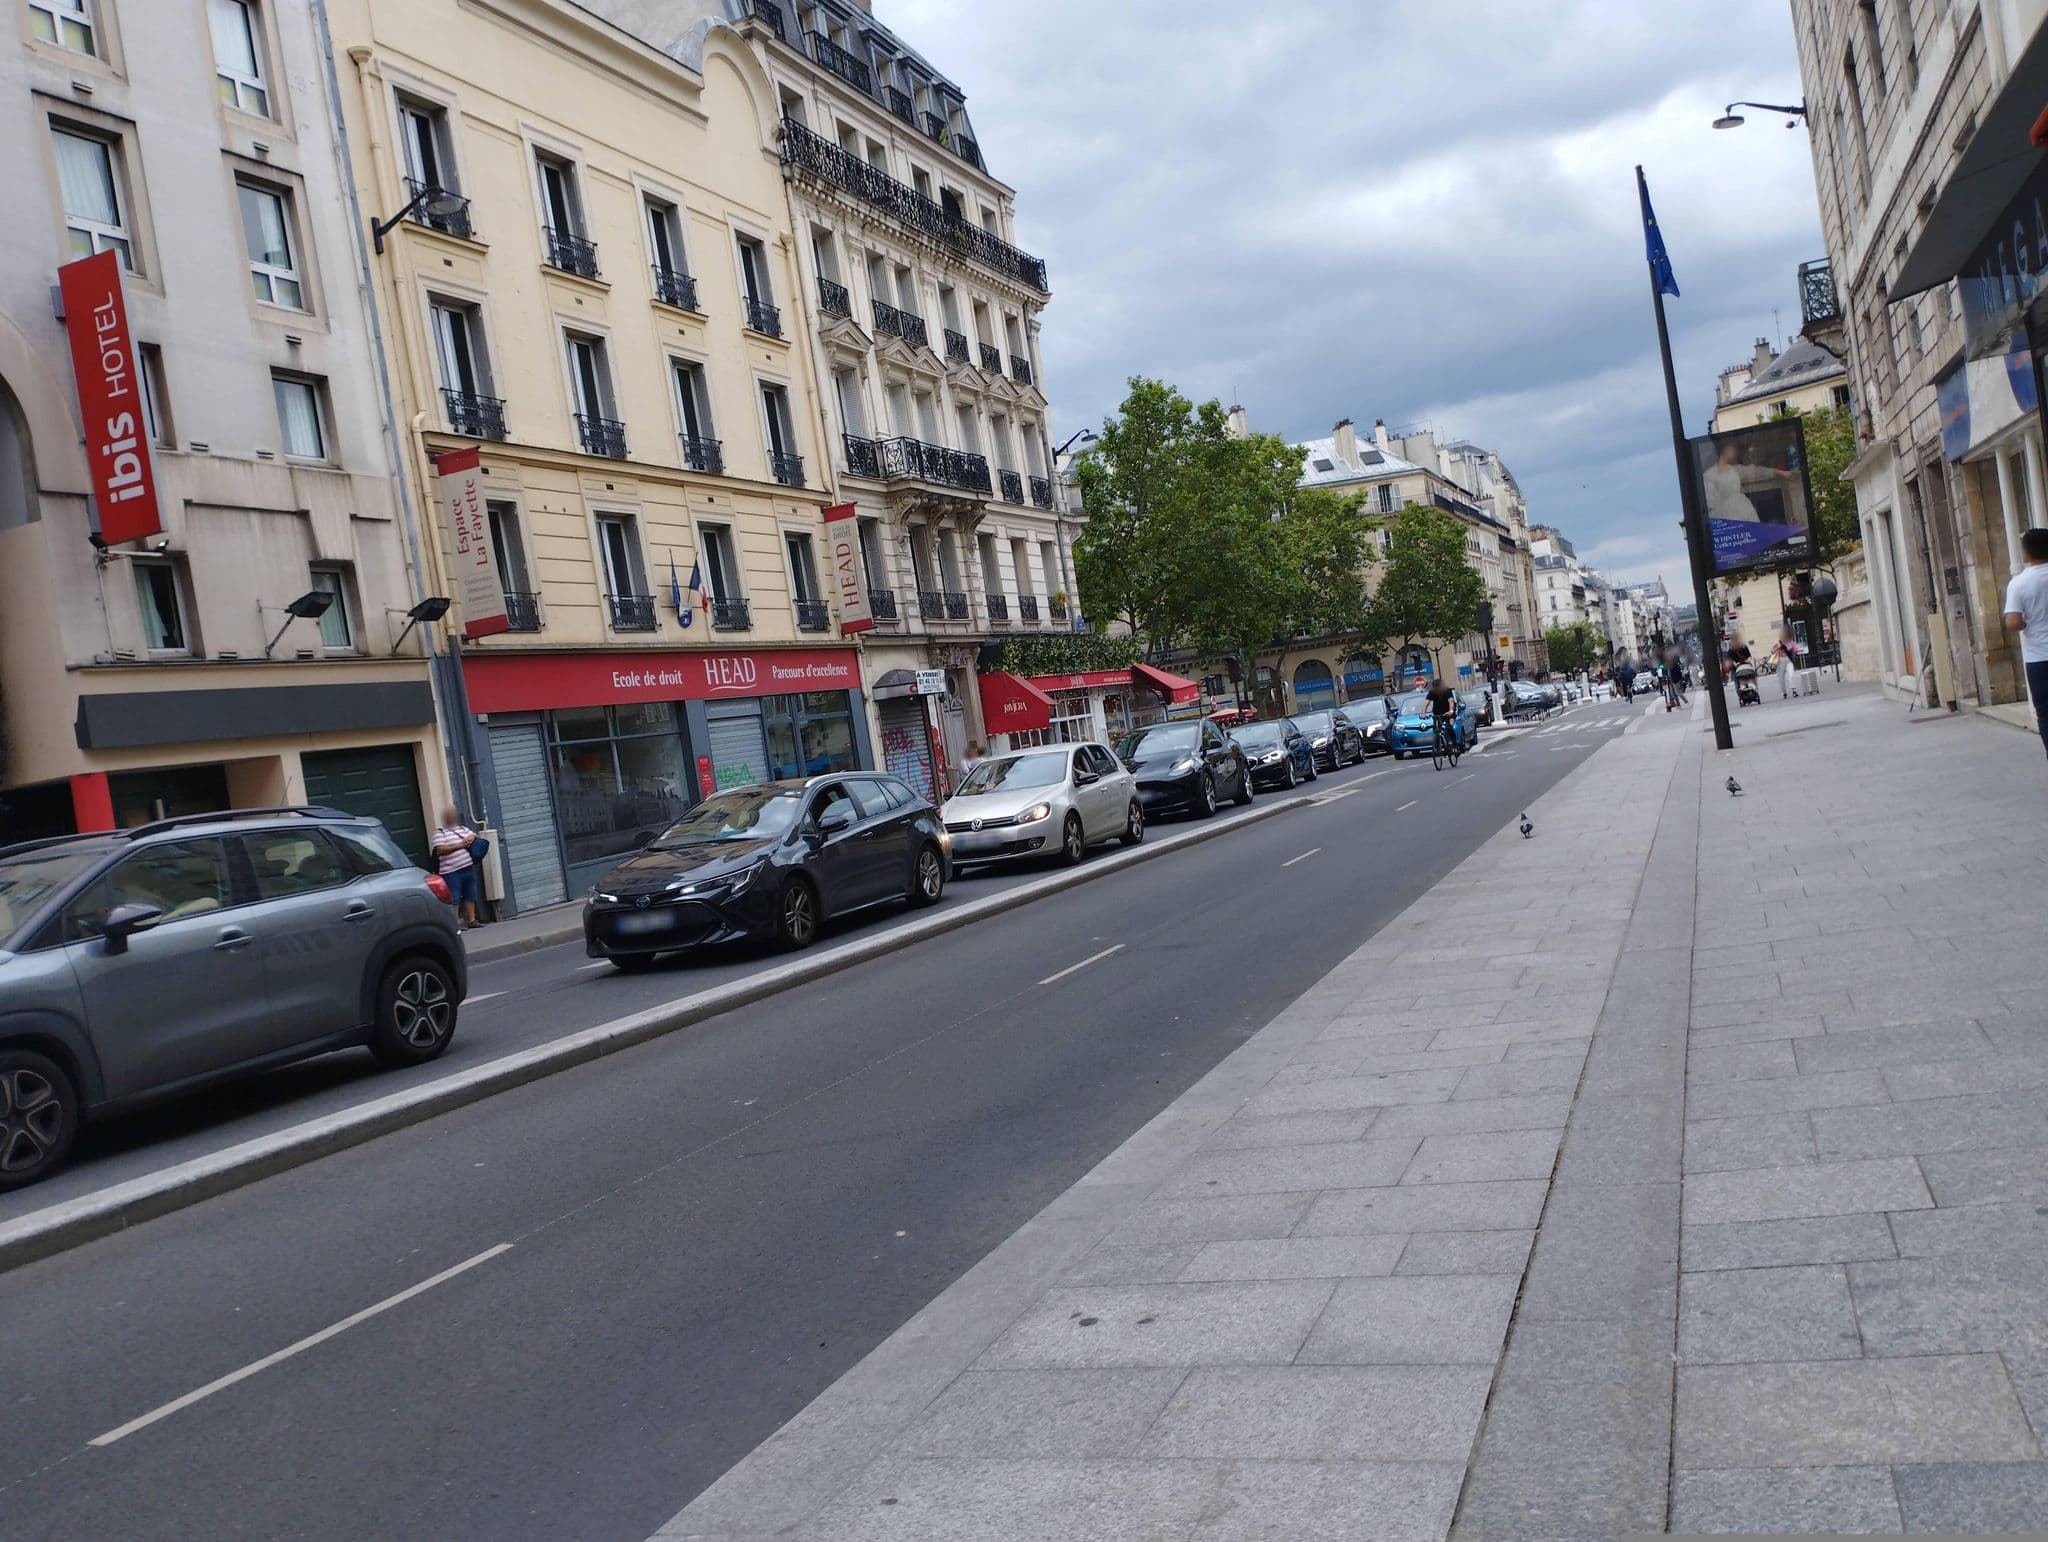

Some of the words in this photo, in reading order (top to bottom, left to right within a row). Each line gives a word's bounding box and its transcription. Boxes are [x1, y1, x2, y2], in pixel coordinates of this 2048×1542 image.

[94, 291, 128, 398] HOTEL
[103, 411, 145, 504] ibis
[453, 499, 470, 555] Espace
[465, 479, 484, 543] Fayette
[476, 546, 488, 566] La
[836, 543, 859, 608] HEAD
[612, 671, 641, 688] Ecole
[644, 670, 656, 686] de
[659, 669, 683, 685] droit
[703, 658, 756, 685] HEAD
[772, 665, 805, 679] Parcours
[806, 663, 849, 678] d'excellence
